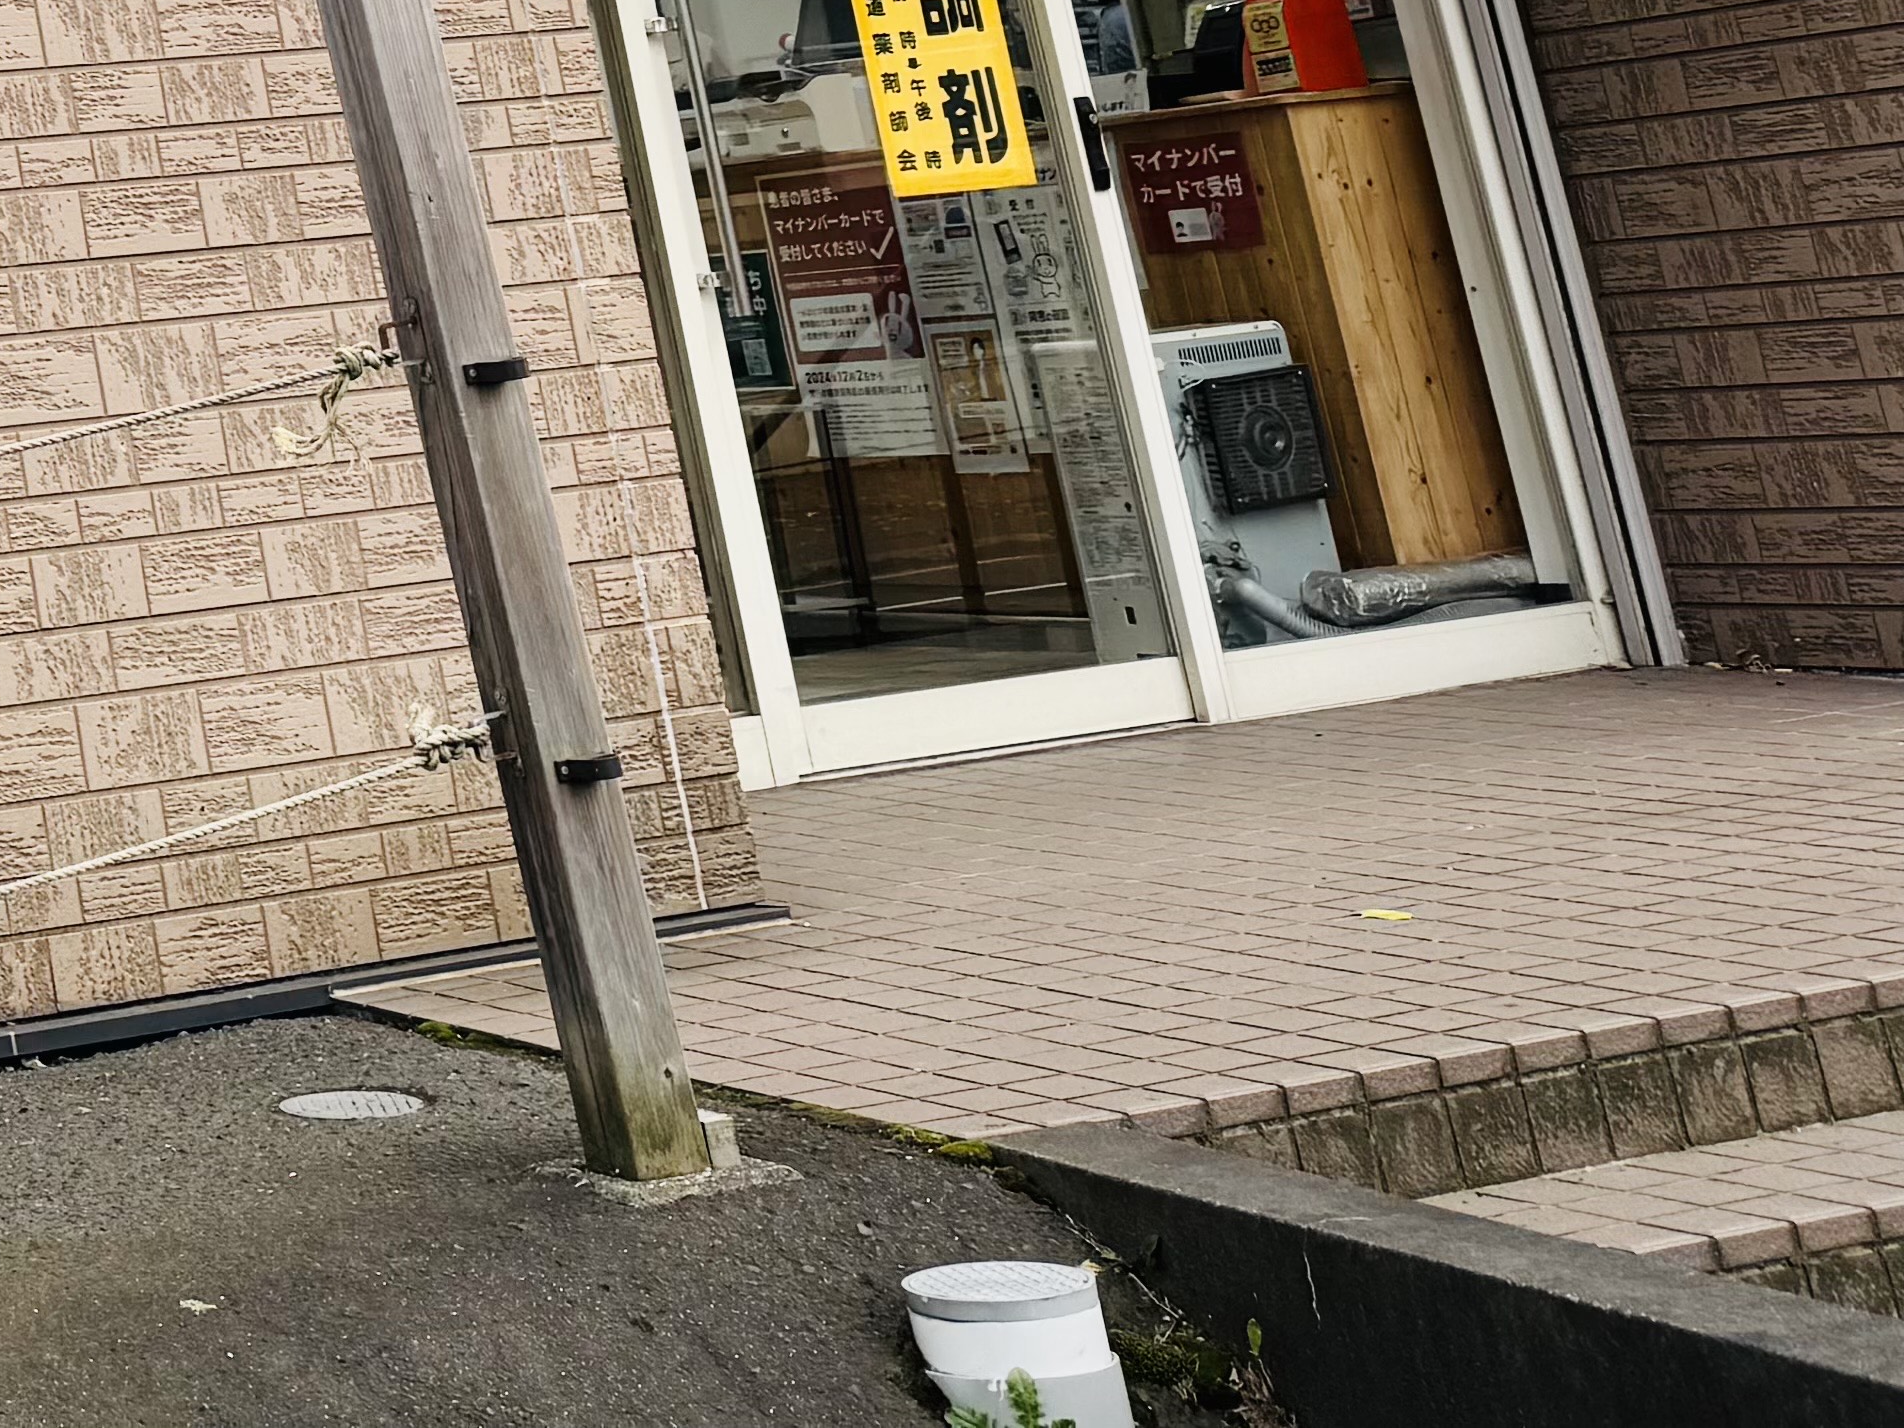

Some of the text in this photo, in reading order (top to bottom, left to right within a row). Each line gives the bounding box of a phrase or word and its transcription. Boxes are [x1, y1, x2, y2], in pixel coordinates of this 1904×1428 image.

[1130, 143, 1236, 173] マイナンバー
[1140, 173, 1244, 204] カードで受付
[773, 208, 885, 236] マイナンバーカードで
